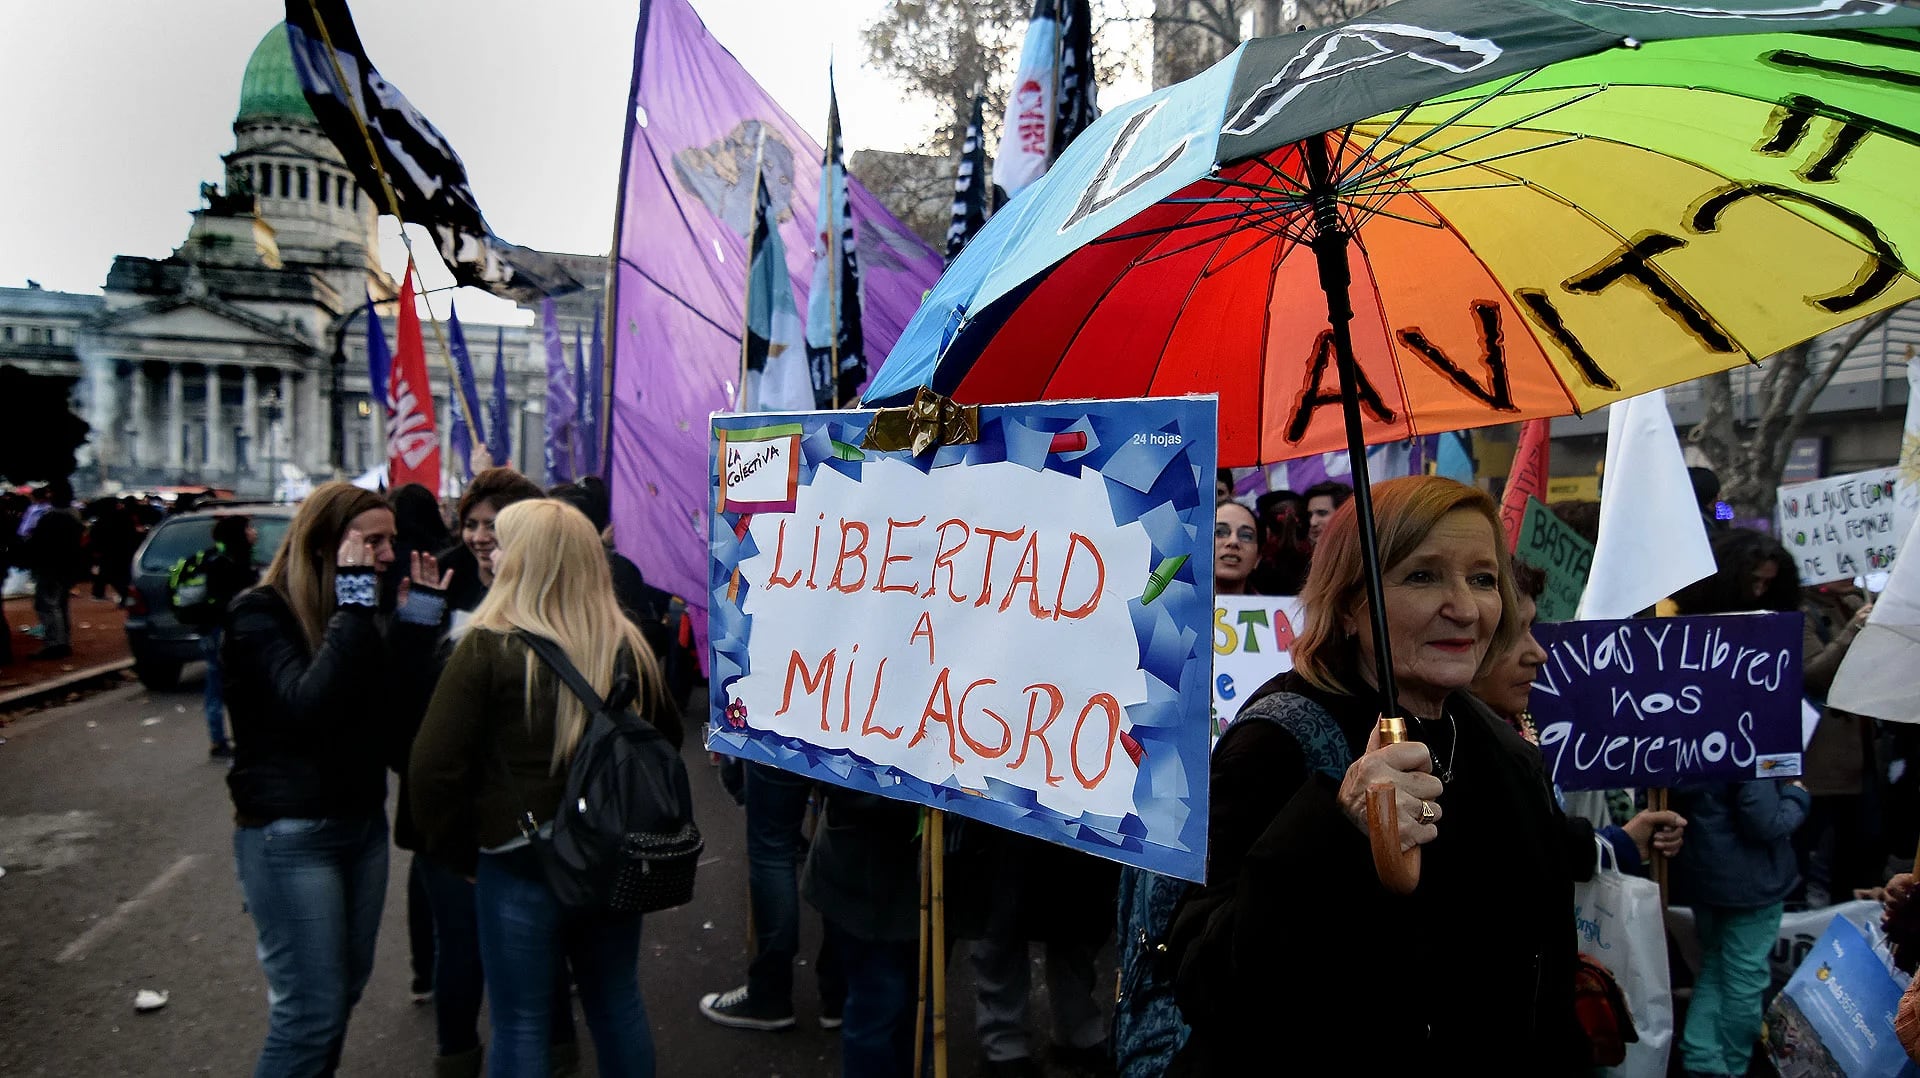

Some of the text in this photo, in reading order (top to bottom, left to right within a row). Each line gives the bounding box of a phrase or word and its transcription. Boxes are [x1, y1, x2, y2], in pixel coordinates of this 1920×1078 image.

[728, 448, 741, 468] LA
[1133, 432, 1182, 448] 24 hojas
[1530, 508, 1595, 585] BASTA
[909, 611, 934, 665] A
[1644, 624, 1672, 672] Y
